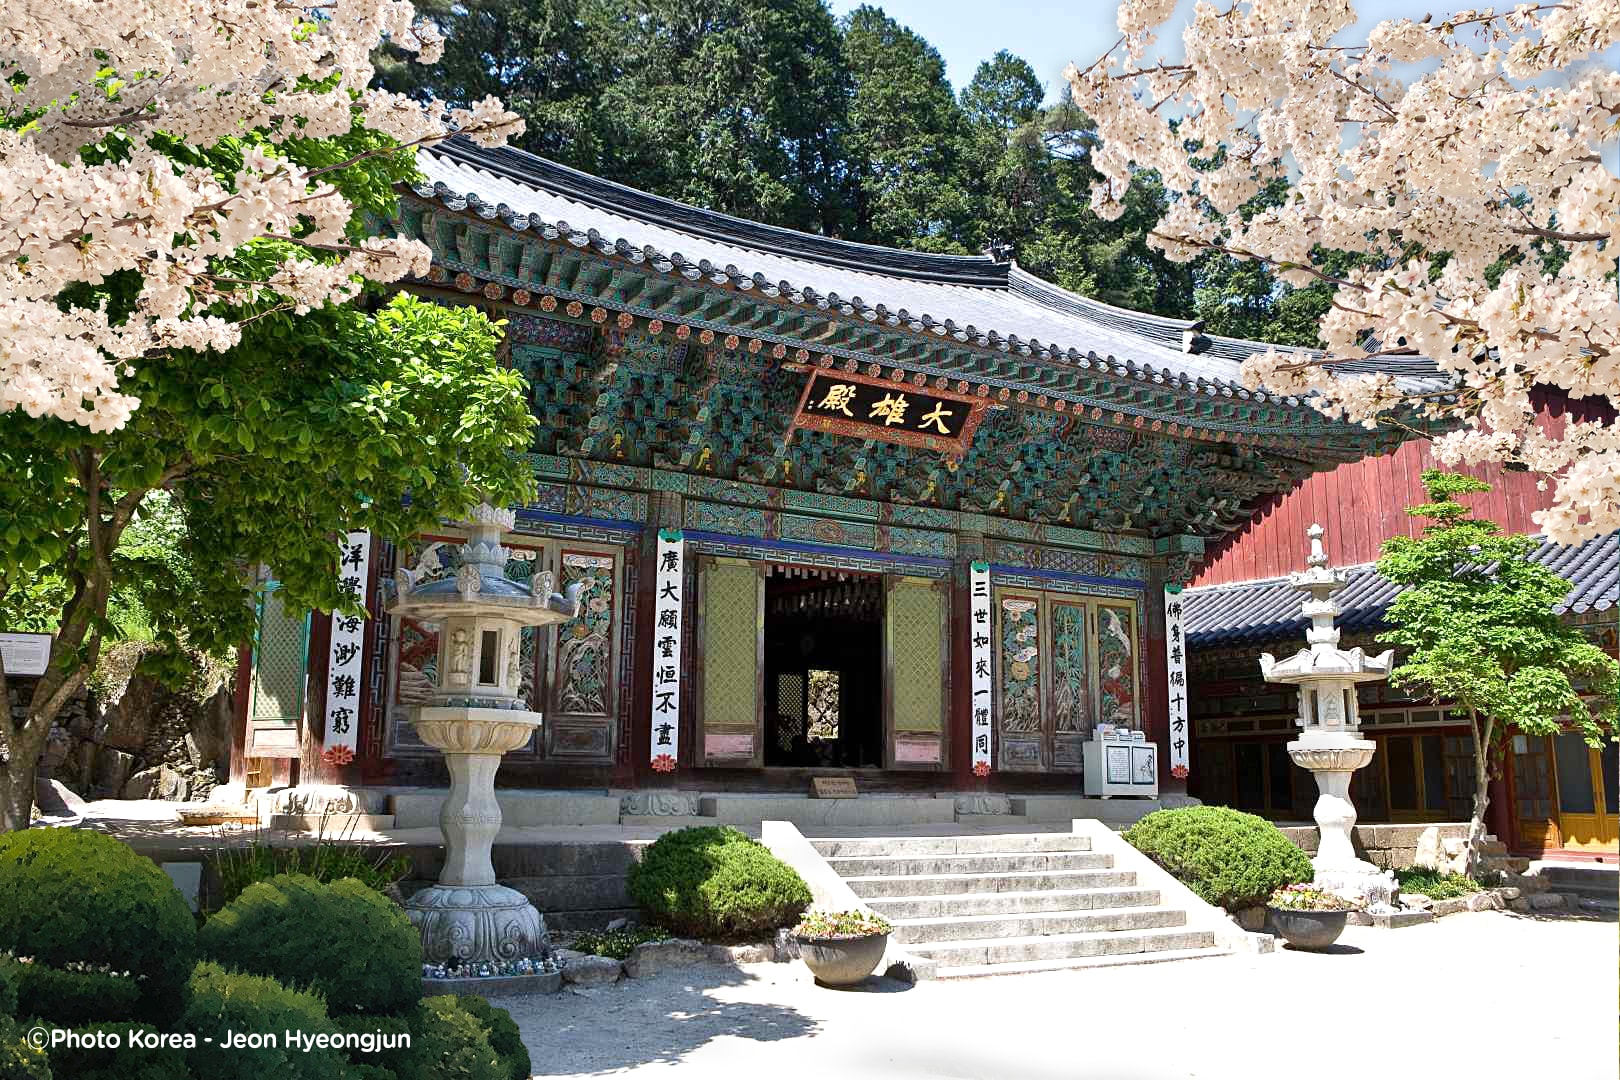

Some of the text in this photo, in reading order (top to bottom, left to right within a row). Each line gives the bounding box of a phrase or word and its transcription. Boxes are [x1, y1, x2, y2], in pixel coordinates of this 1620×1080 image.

[818, 384, 953, 434] 大雄殿
[330, 529, 367, 735] 洋海渺難窮
[973, 581, 990, 754] 三世如來一體同
